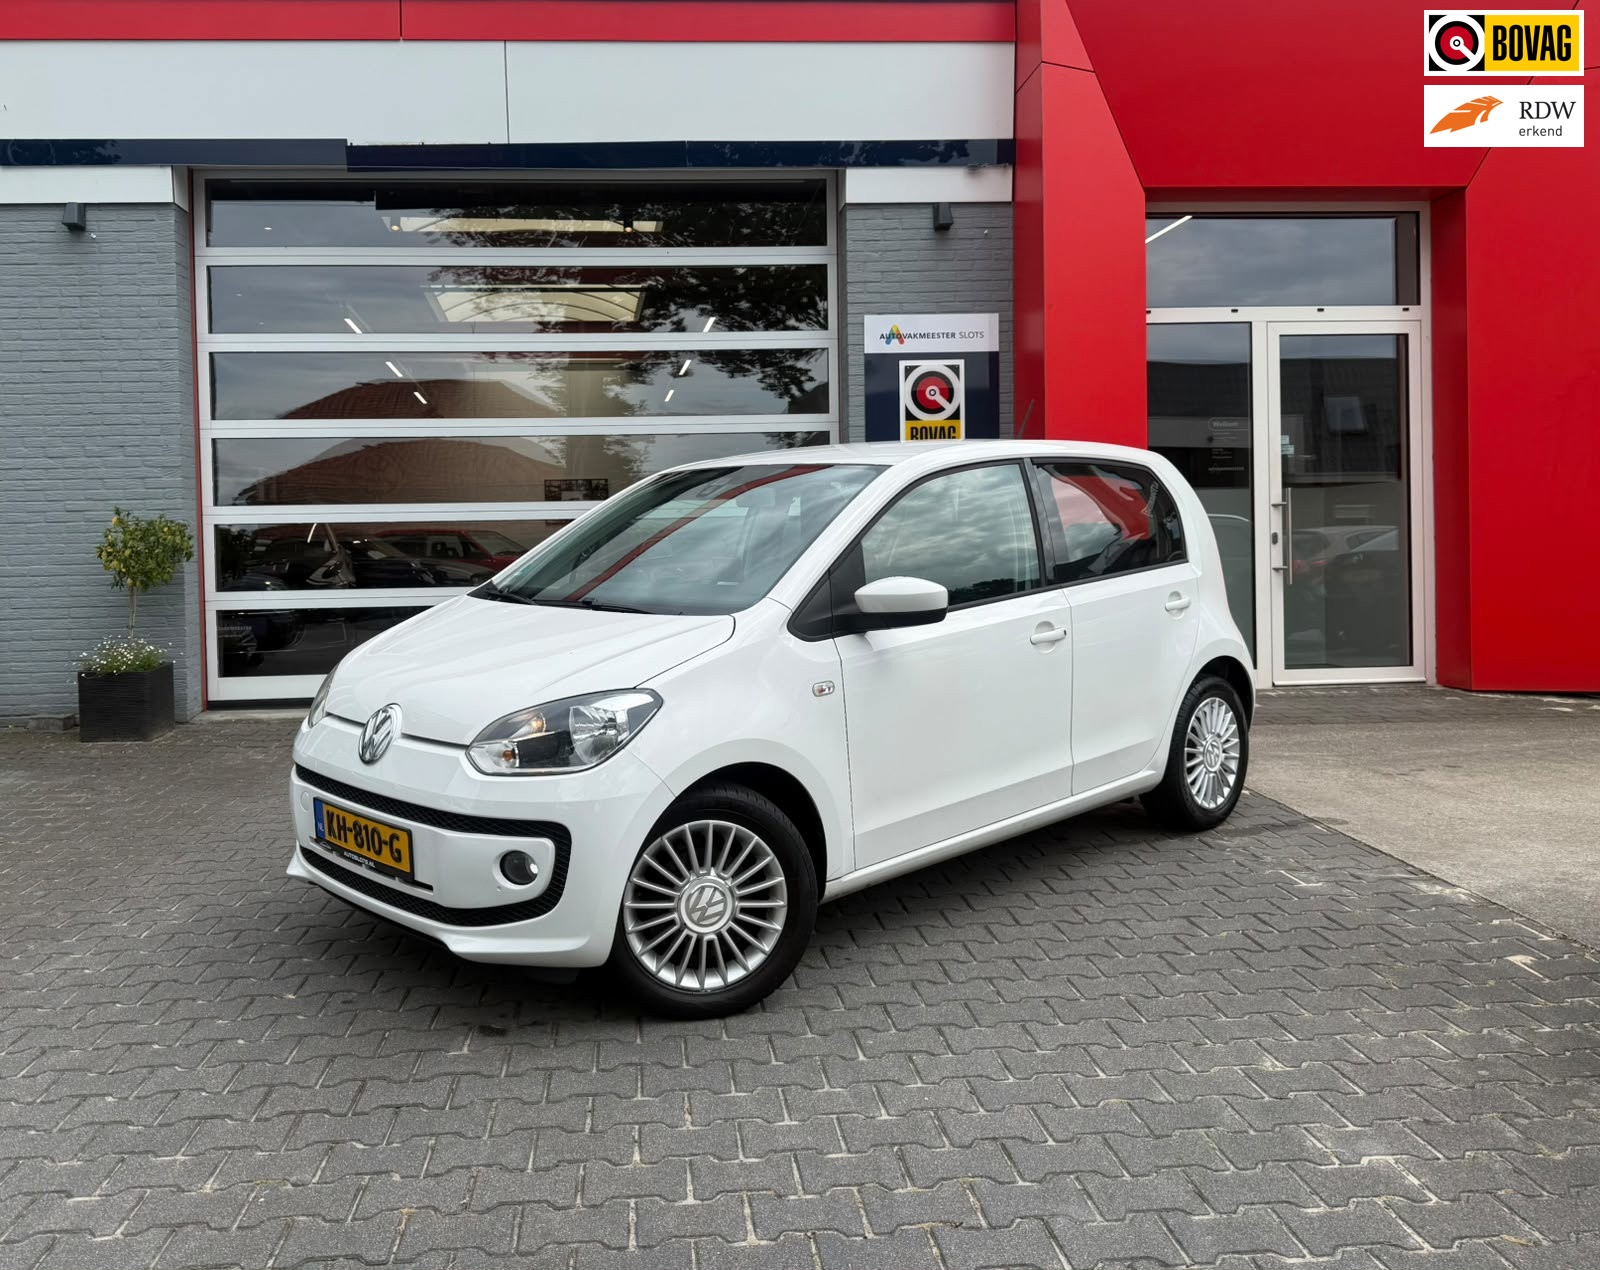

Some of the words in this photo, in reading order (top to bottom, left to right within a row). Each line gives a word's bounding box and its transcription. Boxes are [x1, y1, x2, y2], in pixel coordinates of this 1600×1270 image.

[879, 332, 956, 340] AUTOVAKMEESTER
[958, 331, 985, 339] SLOTS
[325, 809, 403, 864] KH-810-G
